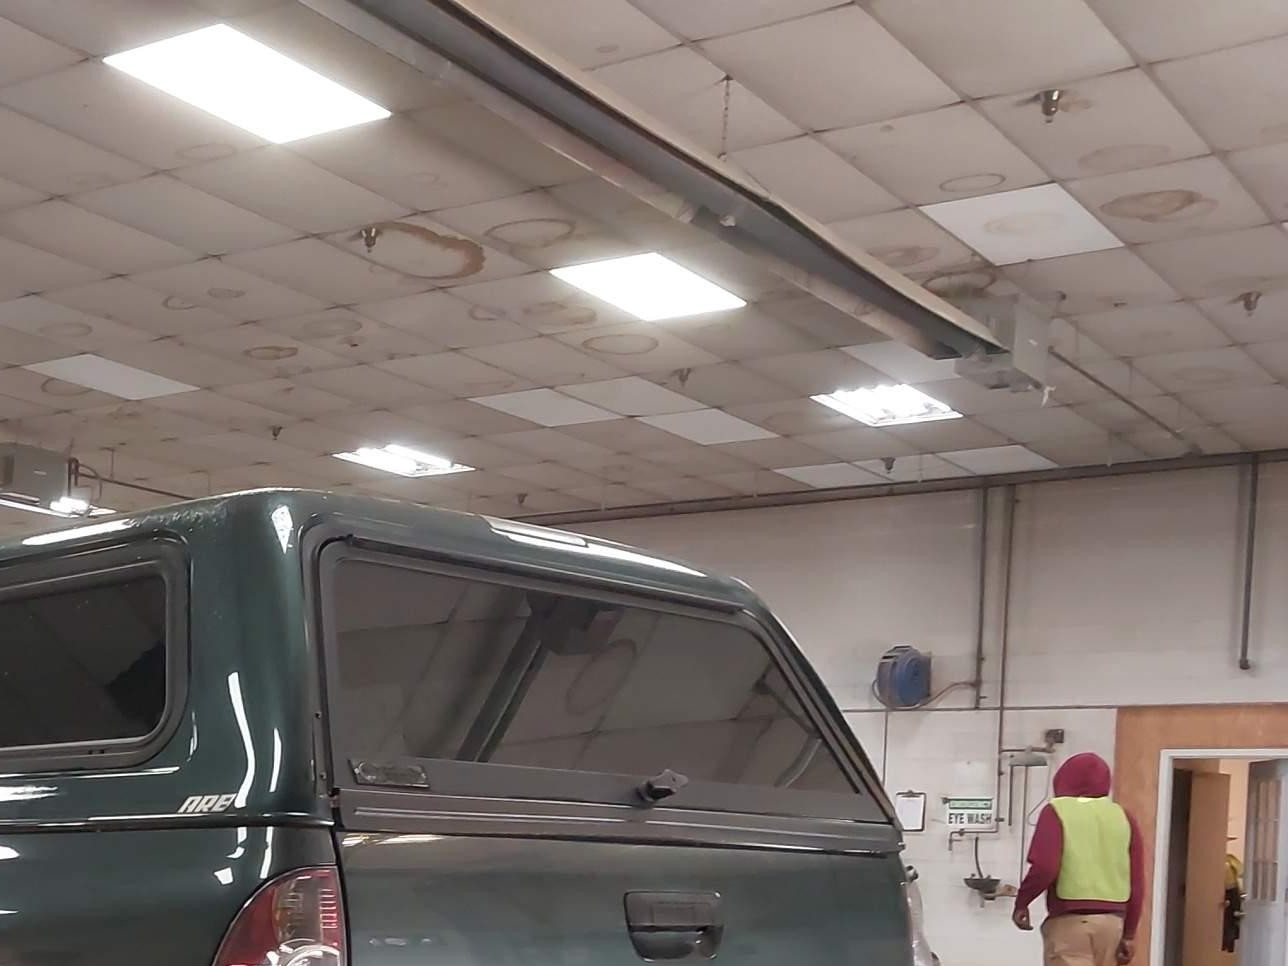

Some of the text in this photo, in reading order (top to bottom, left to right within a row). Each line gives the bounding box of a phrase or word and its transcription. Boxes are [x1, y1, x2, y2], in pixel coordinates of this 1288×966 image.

[177, 793, 237, 813] ARE
[948, 812, 993, 825] EYE WASH
